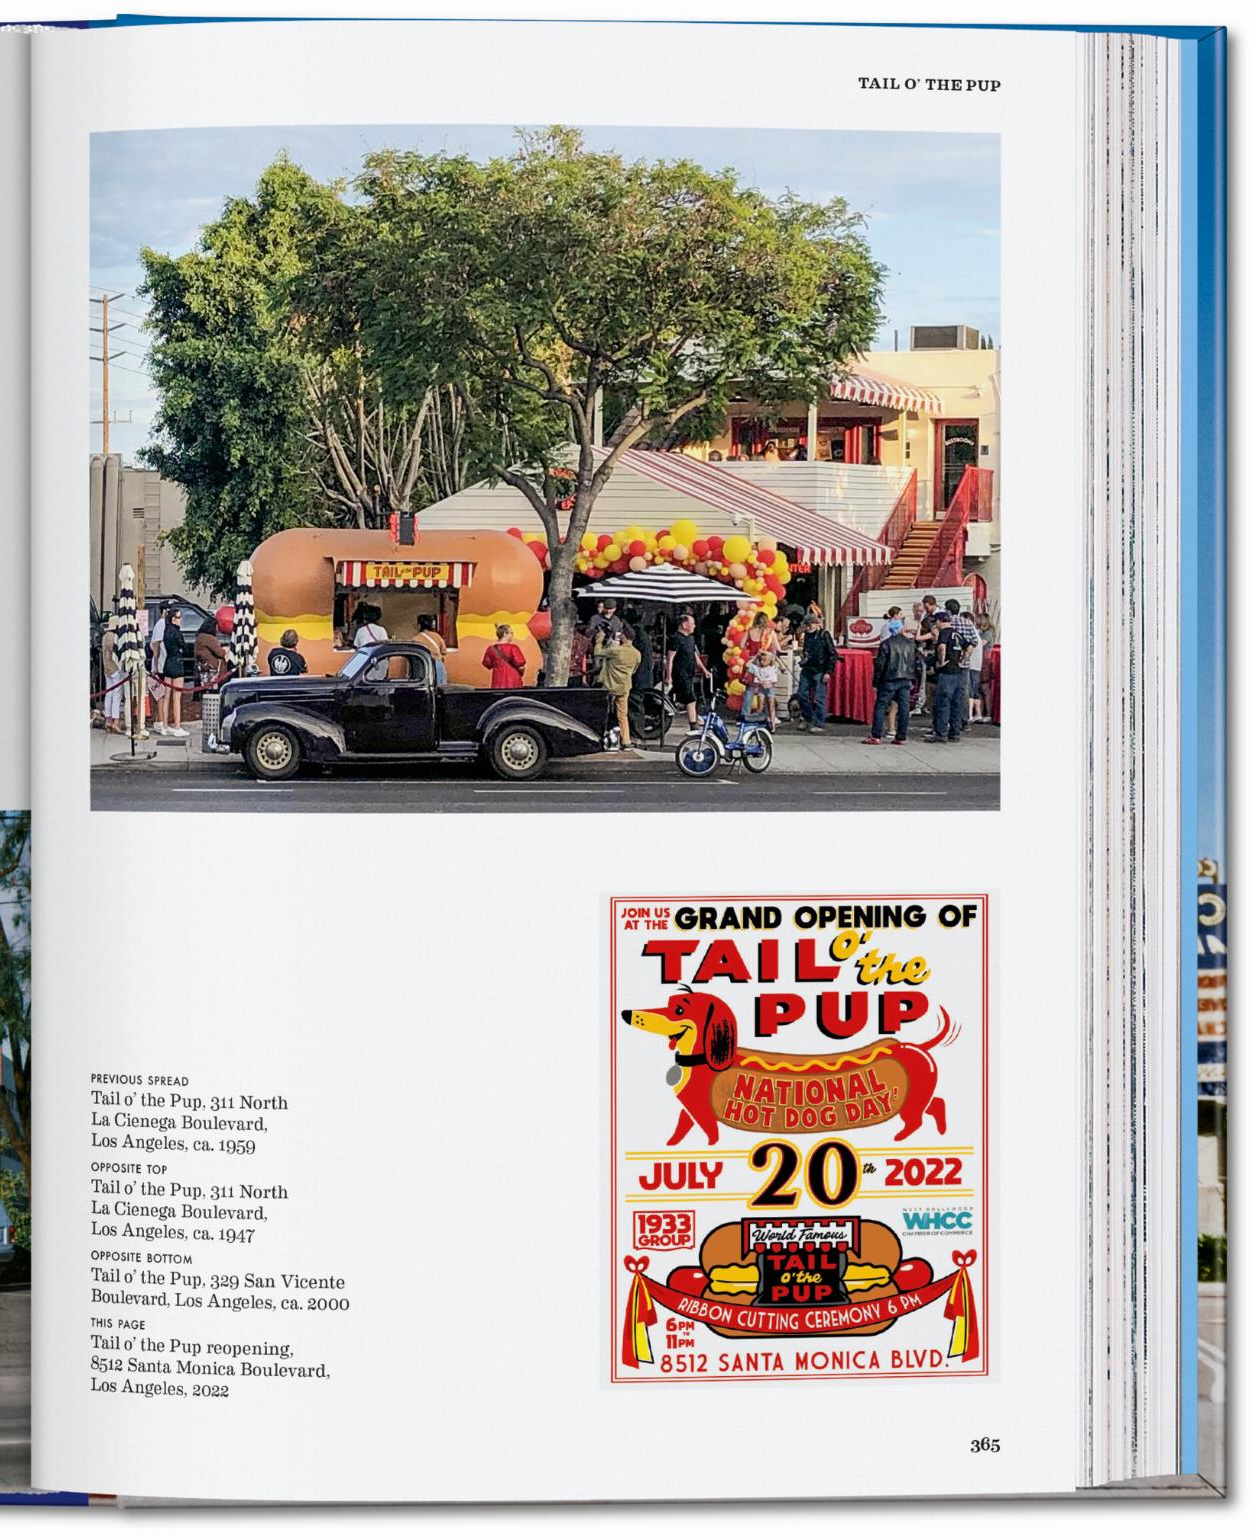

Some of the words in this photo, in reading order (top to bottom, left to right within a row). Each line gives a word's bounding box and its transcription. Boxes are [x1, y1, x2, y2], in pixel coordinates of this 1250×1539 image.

[858, 77, 900, 90] TAIL
[925, 78, 963, 91] THE
[965, 79, 1001, 92] PUP
[373, 565, 402, 578] TAIL
[412, 565, 442, 578] PUP
[621, 907, 651, 919] JOIN
[654, 907, 671, 919] US
[674, 906, 782, 930] GRAND
[794, 905, 927, 929] OPENING
[938, 904, 977, 928] OF
[624, 919, 640, 930] AT
[644, 919, 669, 930] THE
[641, 938, 841, 984] TAIL
[854, 947, 931, 985] the
[754, 991, 929, 1040] PUP
[91, 1073, 143, 1085] PREVIOUS
[148, 1075, 189, 1087] SPREAD
[733, 1068, 888, 1106] NATIONAL
[90, 1090, 121, 1106] Tail
[141, 1092, 166, 1108] the
[170, 1093, 206, 1112] Pup,
[210, 1096, 234, 1112] 311
[239, 1095, 288, 1110] North
[91, 1111, 111, 1127] La
[114, 1112, 177, 1132] Cienega
[181, 1115, 268, 1132] Boulevard,
[723, 1099, 776, 1127] HOT
[785, 1105, 838, 1129] DOG
[91, 1132, 118, 1148] Los
[121, 1134, 188, 1153] Angeles,
[193, 1140, 214, 1152] ca.
[220, 1139, 256, 1155] 1959
[90, 1161, 142, 1174] OPPOSITE
[146, 1164, 168, 1175] TOP
[639, 1161, 723, 1191] JULY
[884, 1157, 963, 1186] 2022
[91, 1178, 121, 1194] Tail
[141, 1181, 165, 1197] the
[170, 1182, 206, 1201] Pup,
[210, 1185, 234, 1201] 311
[239, 1184, 288, 1200] North
[91, 1200, 111, 1215] La
[114, 1201, 176, 1221] Cienega
[181, 1204, 268, 1221] Boulevard,
[902, 1211, 973, 1230] WHCC
[91, 1221, 117, 1237] Los
[121, 1222, 188, 1242] Angeles,
[193, 1229, 214, 1241] ca.
[219, 1228, 256, 1244] 1947
[637, 1213, 692, 1235] 1933
[638, 1234, 692, 1247] GROUP
[752, 1228, 796, 1242] World
[798, 1228, 848, 1241] Famous
[90, 1250, 142, 1263] OPPOSITE
[147, 1253, 193, 1265] BOTTOM
[767, 1254, 838, 1271] TAIL
[90, 1267, 120, 1283] Tail
[140, 1270, 165, 1286] the
[170, 1271, 206, 1290] Pup,
[210, 1274, 240, 1290] 329
[244, 1273, 275, 1288] San
[281, 1274, 345, 1290] Vicente
[91, 1288, 170, 1306] Boulevard,
[175, 1292, 203, 1308] Los
[207, 1293, 276, 1312] Angeles,
[280, 1298, 303, 1310] ca.
[307, 1297, 350, 1311] 2000
[771, 1284, 833, 1302] PUP
[678, 1297, 733, 1324] RIBBON
[737, 1310, 799, 1331] CUTTING
[805, 1302, 881, 1329] CEREMONY
[887, 1300, 898, 1315] 6
[900, 1292, 923, 1310] PM
[90, 1317, 113, 1329] THIS
[118, 1319, 145, 1330] PAGE
[90, 1334, 120, 1350] Tail
[140, 1337, 165, 1353] the
[169, 1338, 202, 1357] Pup
[207, 1341, 294, 1360] reopening,
[90, 1355, 123, 1373] 8512
[127, 1357, 172, 1374] Santa
[176, 1360, 236, 1376] Monica
[240, 1362, 330, 1378] Boulevard,
[660, 1353, 708, 1373] 8512
[719, 1352, 784, 1372] SANTA
[795, 1350, 880, 1371] MONICA
[891, 1349, 949, 1369] BLVD.
[90, 1377, 117, 1393] Los
[121, 1378, 188, 1398] Angeles,
[192, 1384, 229, 1398] 2022
[970, 1436, 1001, 1453] 365
